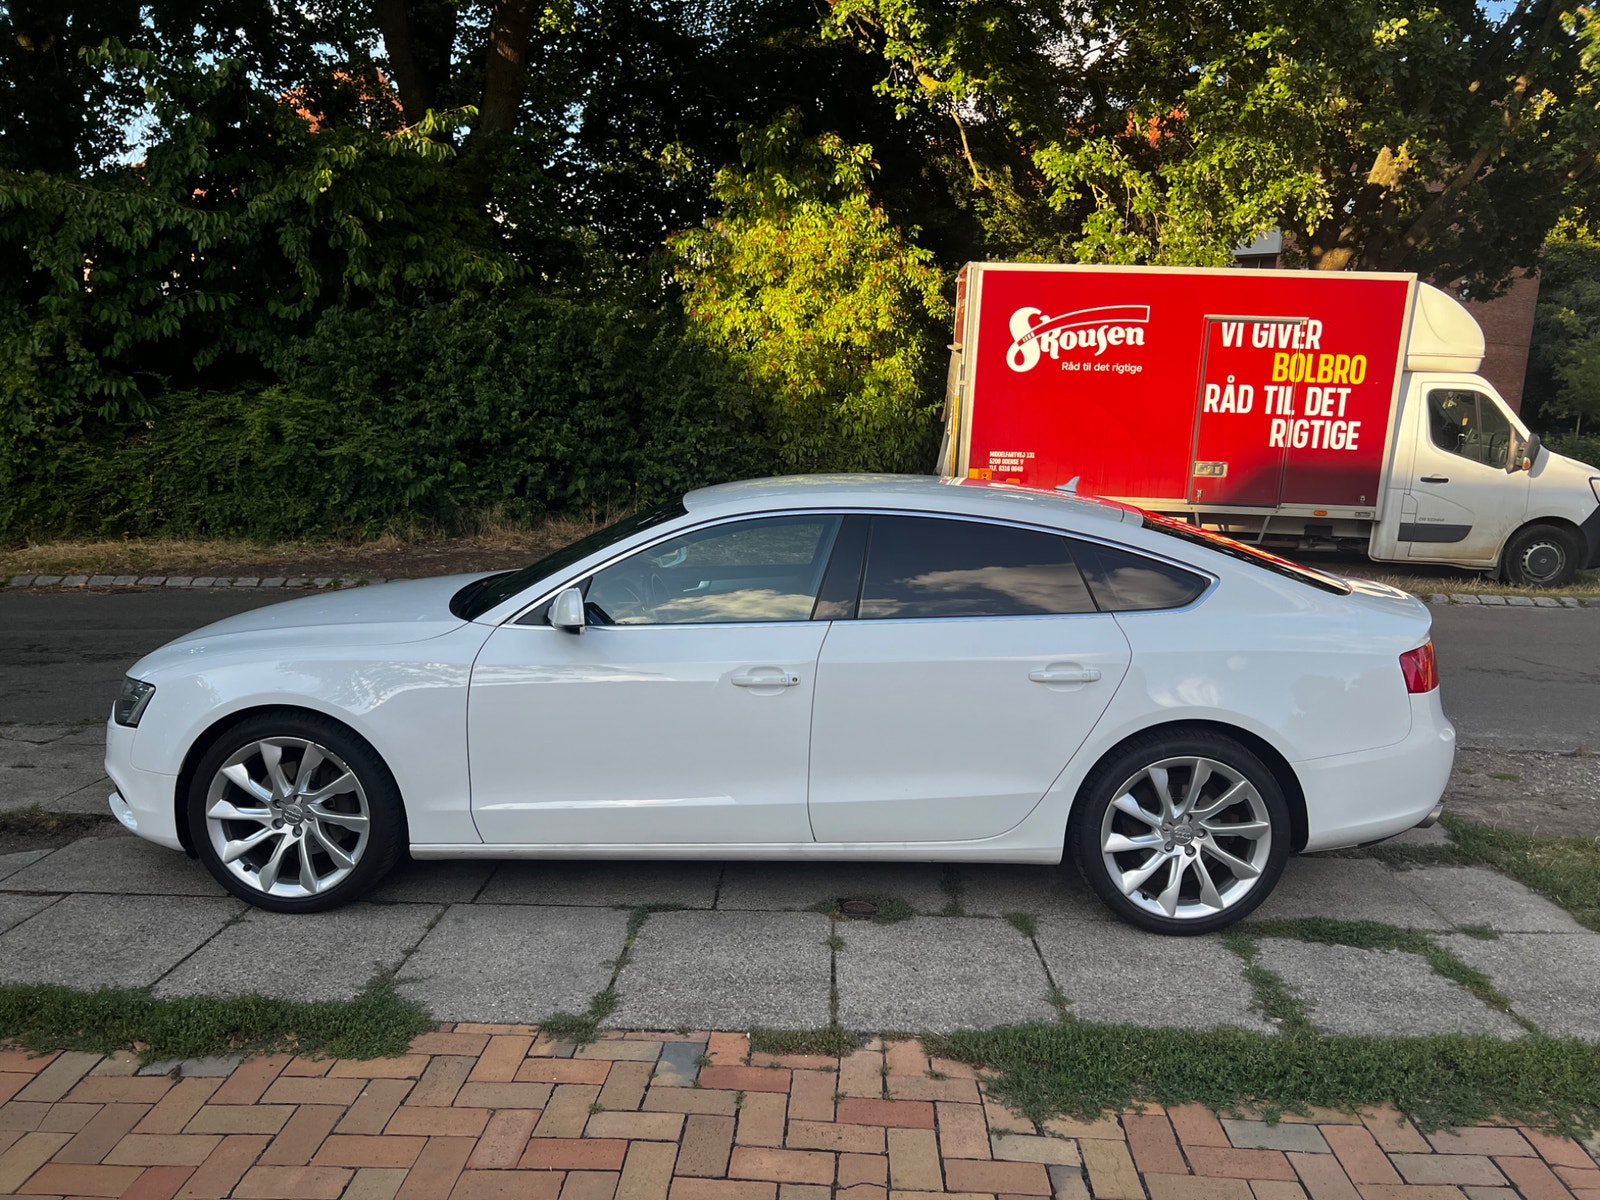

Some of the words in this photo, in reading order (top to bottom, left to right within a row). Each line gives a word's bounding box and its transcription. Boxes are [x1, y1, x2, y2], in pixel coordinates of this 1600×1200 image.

[1006, 306, 1145, 373] Skousen
[1221, 322, 1244, 347] VI
[1251, 319, 1322, 350] GIVER
[1061, 361, 1081, 371] Råd
[1083, 362, 1091, 372] til
[1094, 362, 1110, 372] det
[1112, 363, 1143, 375] rigtige
[1271, 352, 1367, 385] BOLBRO
[1203, 374, 1254, 414] RÅD
[1263, 385, 1296, 415] TIL
[1304, 386, 1352, 417] DET
[1269, 418, 1361, 451] RIGTIGE
